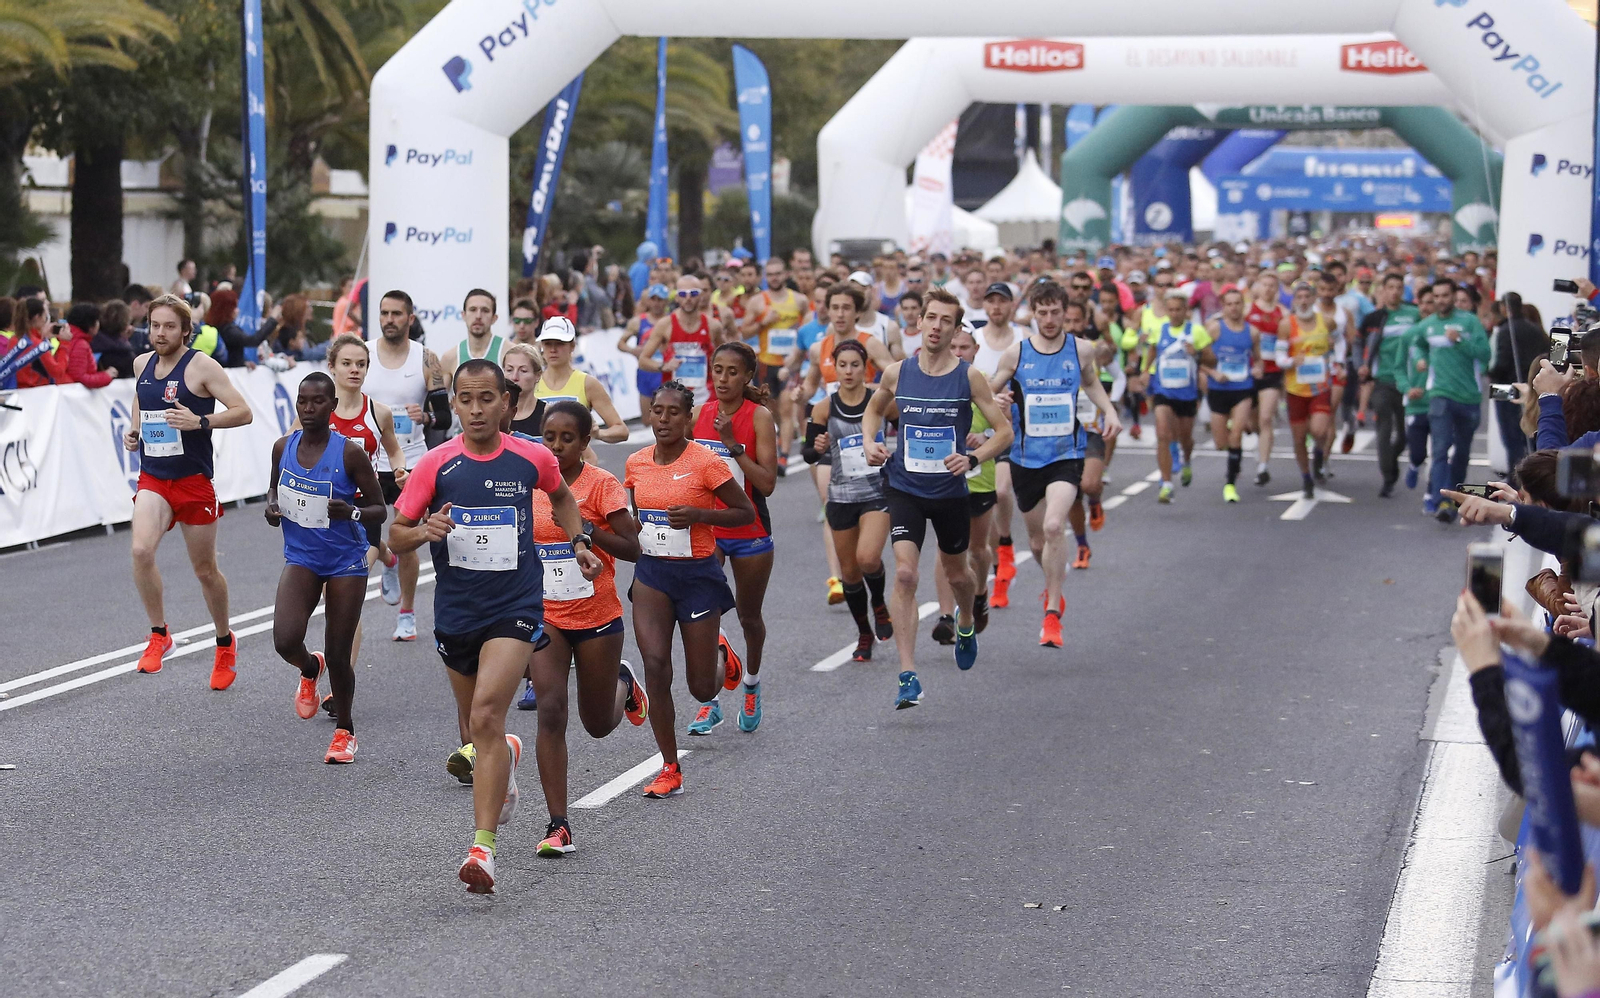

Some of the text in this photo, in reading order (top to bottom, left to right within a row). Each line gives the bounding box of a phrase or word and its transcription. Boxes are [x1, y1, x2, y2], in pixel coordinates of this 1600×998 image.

[479, 0, 556, 62] PayP
[990, 45, 1079, 67] Helios
[1347, 46, 1420, 68] Helio
[1466, 12, 1563, 98] PayPal
[406, 148, 474, 168] PayPal
[1556, 159, 1593, 178] Pay
[405, 226, 474, 246] PayPal
[1553, 239, 1591, 259] Pay
[149, 430, 165, 438] 3508
[711, 446, 730, 454] ZURIC
[924, 446, 935, 454] 60
[296, 482, 318, 492] ZURICH
[296, 498, 307, 508] 18
[473, 514, 501, 522] ZURICH
[475, 534, 489, 545] 25
[656, 532, 667, 541] 16
[552, 567, 564, 577] 15
